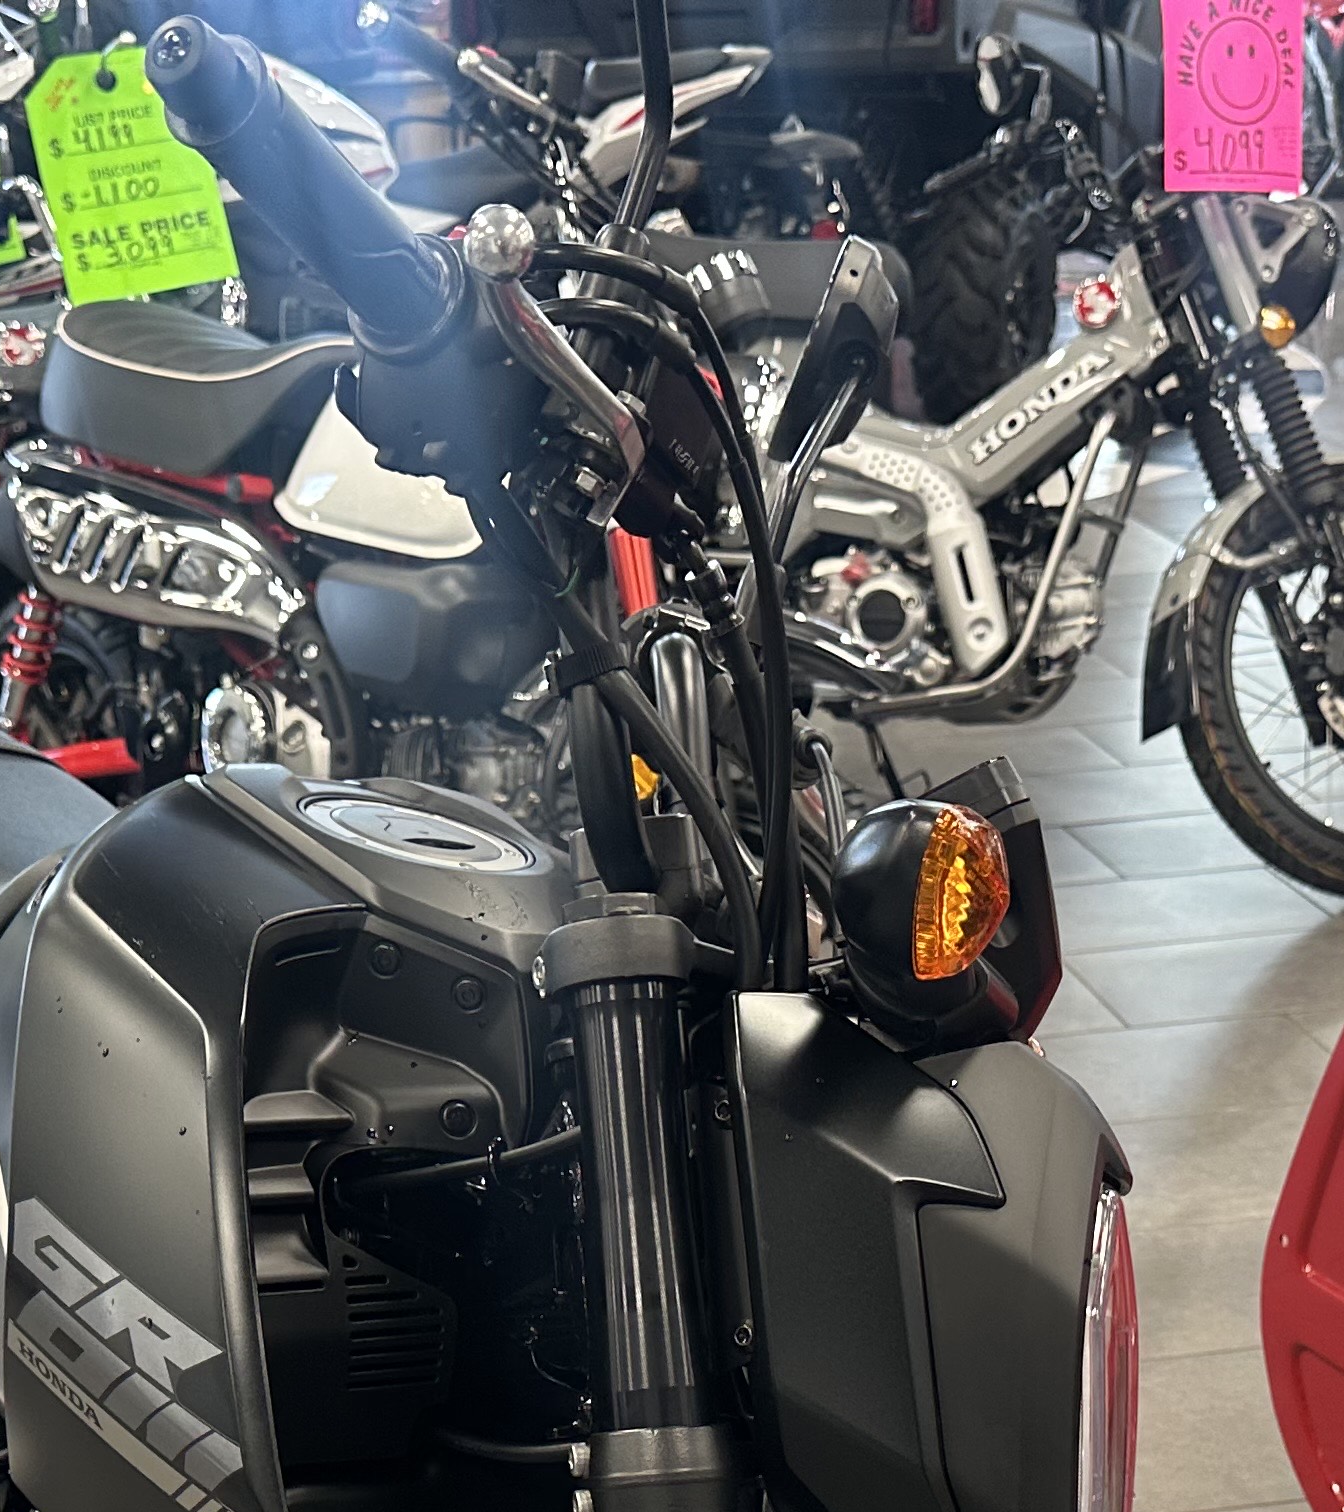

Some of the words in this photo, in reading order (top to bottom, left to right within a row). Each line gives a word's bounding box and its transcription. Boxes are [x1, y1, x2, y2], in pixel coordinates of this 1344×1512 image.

[1177, 19, 1204, 87] HAVE
[1207, 1, 1219, 22] A
[1228, 0, 1276, 24] NICE
[1275, 28, 1295, 90] DEAL
[73, 111, 104, 129] LIST
[108, 104, 154, 124] PRICE
[49, 138, 65, 160] $
[1172, 150, 1188, 172] $
[88, 159, 162, 182] DISCOUNT
[61, 193, 77, 214] $
[71, 224, 132, 250] SALE
[140, 209, 211, 236] PRICE
[76, 252, 92, 272] $
[967, 352, 1115, 466] HONDA
[17, 1338, 105, 1432] HONDA
